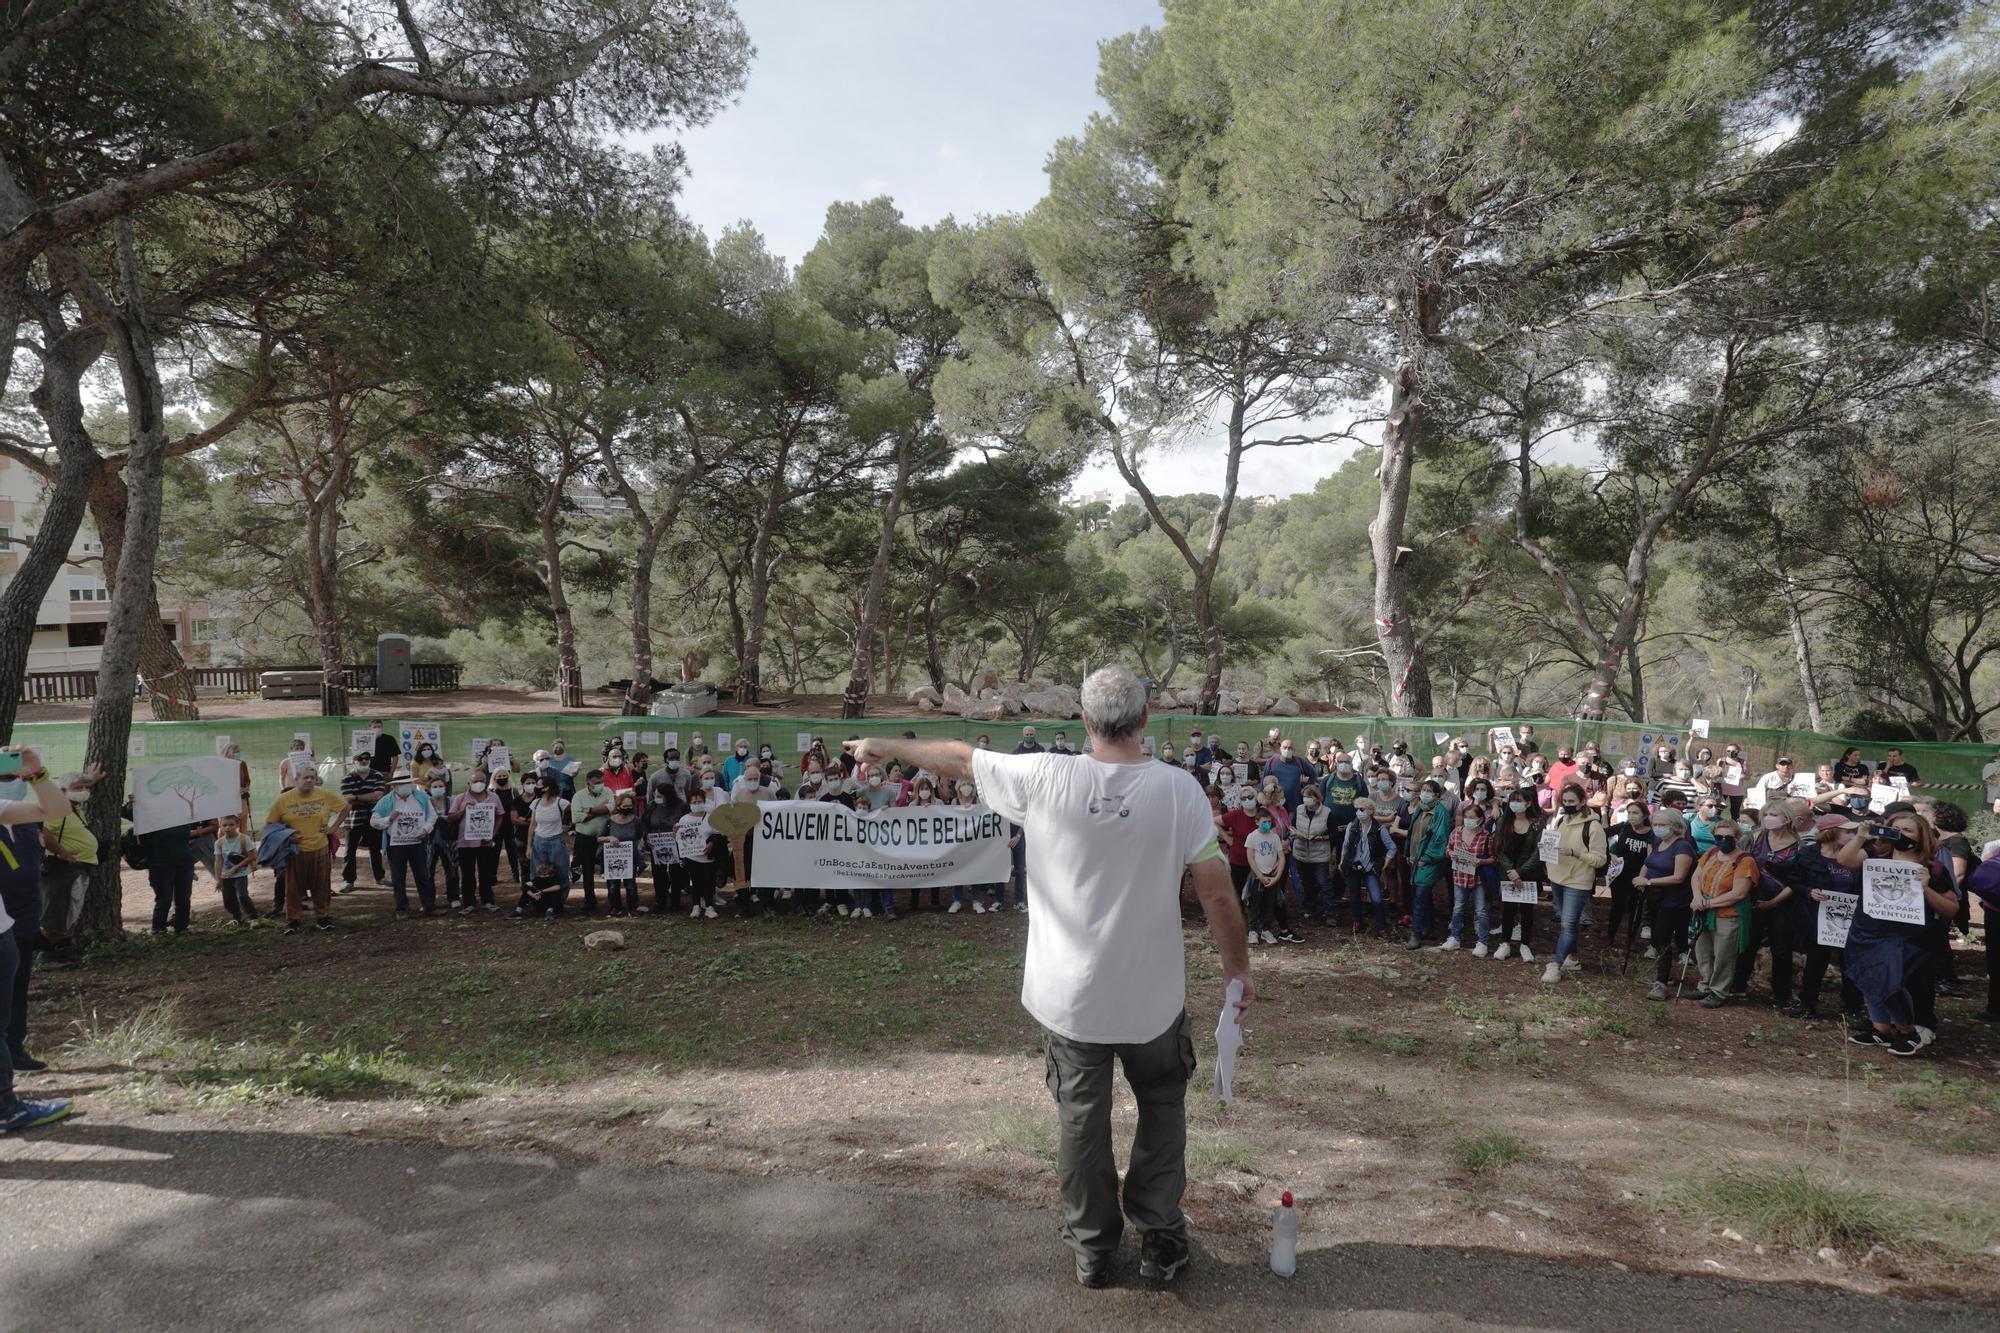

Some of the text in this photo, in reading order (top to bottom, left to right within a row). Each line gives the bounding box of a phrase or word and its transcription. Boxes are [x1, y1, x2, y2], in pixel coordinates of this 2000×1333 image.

[762, 812, 1002, 846] SALVEM EL BOSC DE BELLVER
[1630, 844, 1642, 853] IST
[814, 858, 954, 871] #UnBoscJaEsUnaAventura
[1868, 909, 1921, 920] AVENTURA
[1896, 905, 1921, 914] PARC
